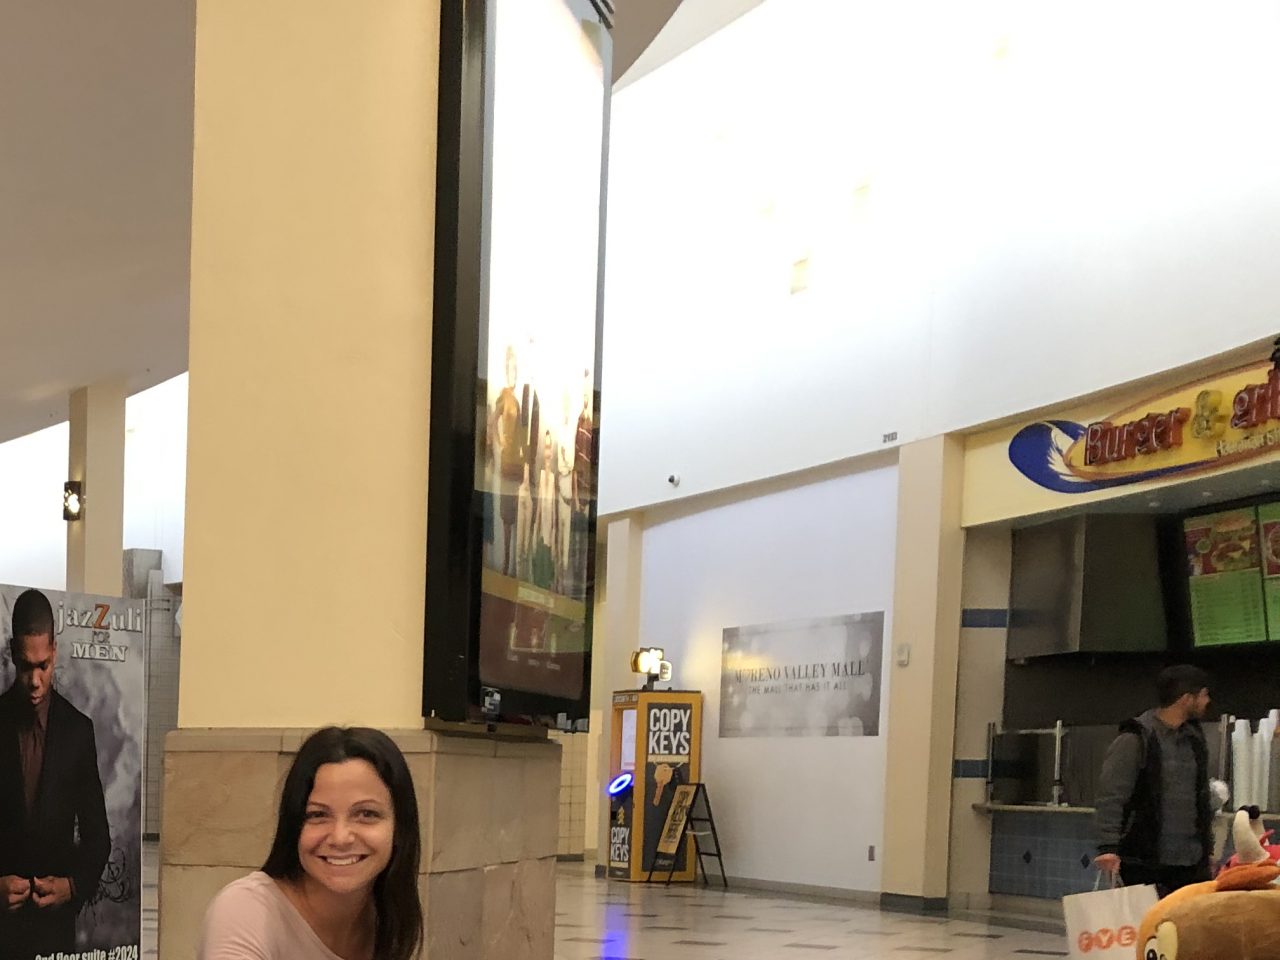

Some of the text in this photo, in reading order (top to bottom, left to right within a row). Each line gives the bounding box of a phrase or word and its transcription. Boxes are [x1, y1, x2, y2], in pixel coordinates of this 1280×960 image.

[1084, 407, 1192, 465] Burger
[57, 601, 142, 635] jazZuli
[92, 630, 111, 643] FOR
[71, 643, 128, 662] MEN
[784, 663, 827, 681] VALLEY
[832, 660, 866, 676] MALL
[805, 682, 820, 692] HAS
[833, 681, 847, 690] ALL
[649, 708, 691, 732] COPY
[648, 731, 690, 755] KEYS
[611, 827, 630, 843] COPY
[610, 843, 629, 861] KEYS
